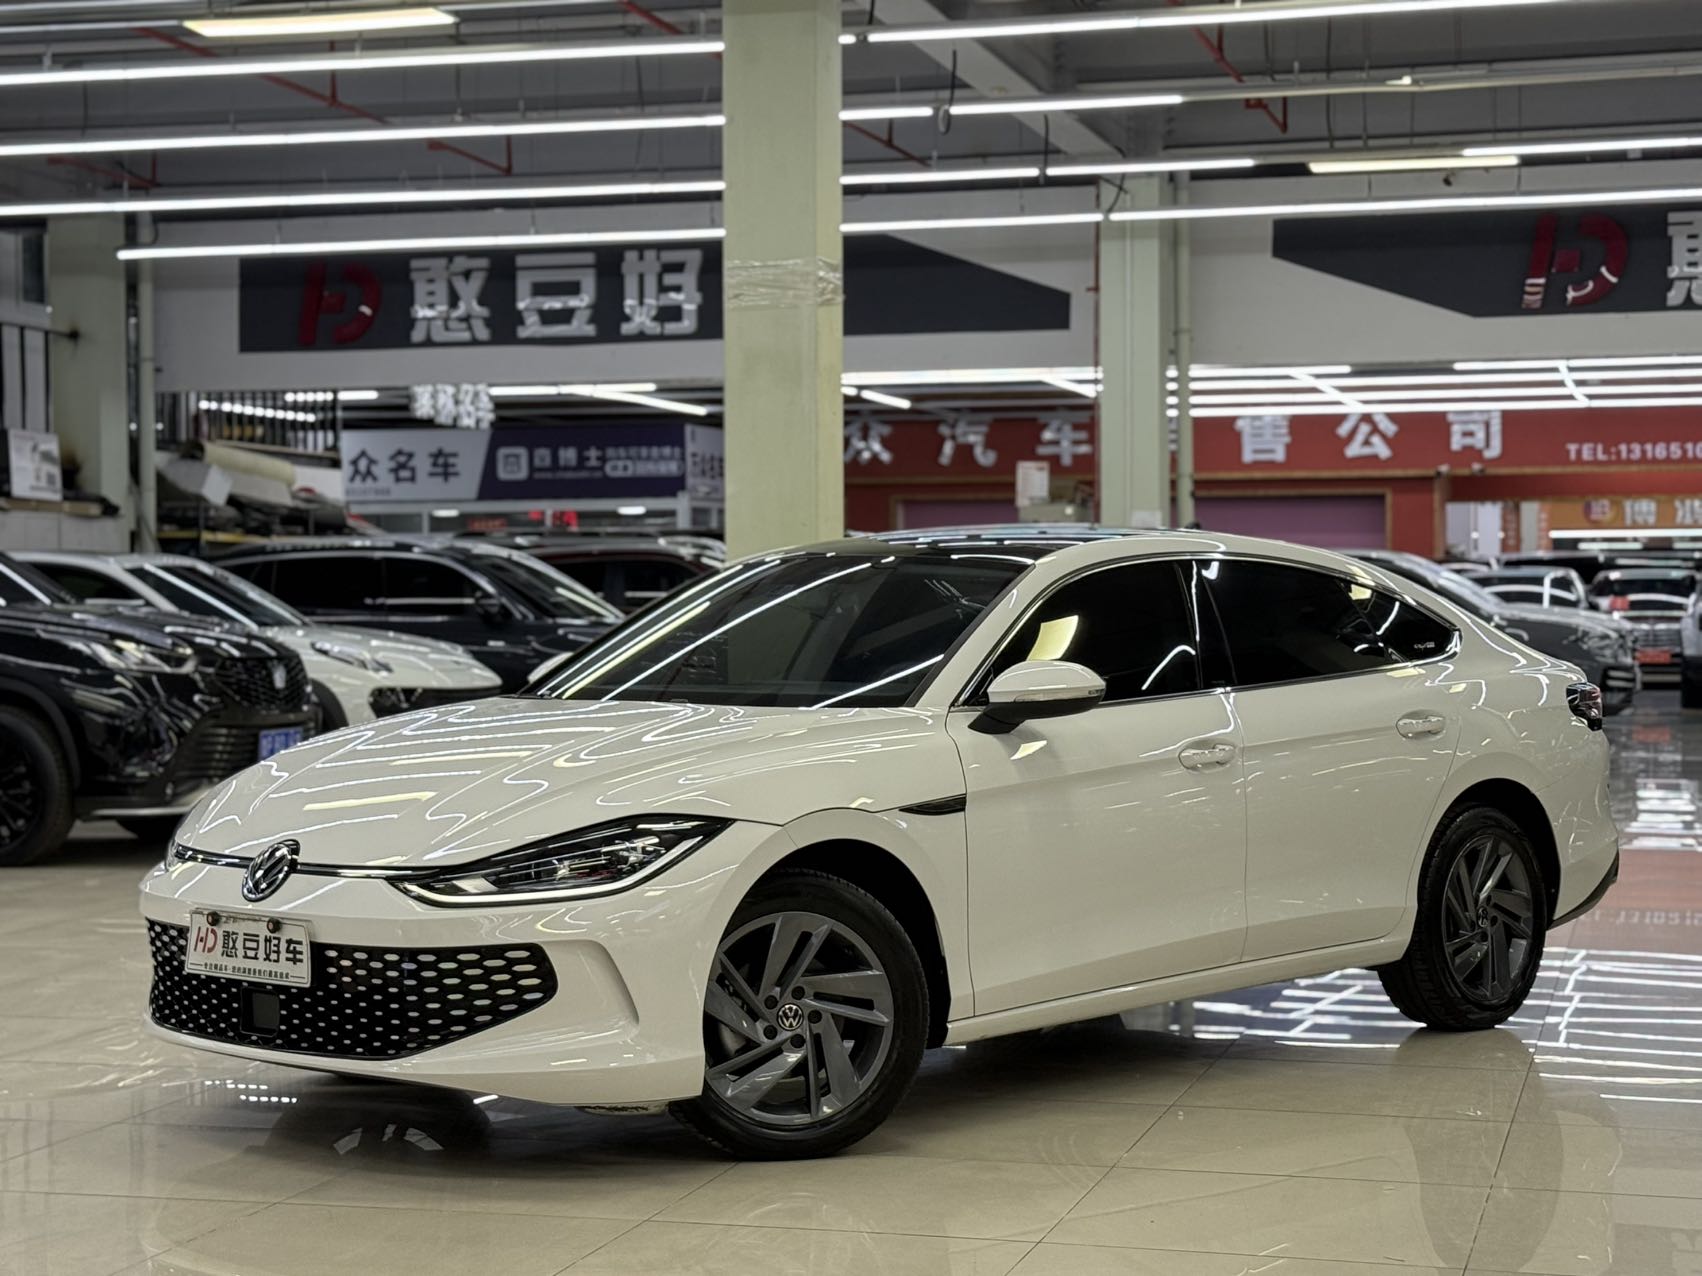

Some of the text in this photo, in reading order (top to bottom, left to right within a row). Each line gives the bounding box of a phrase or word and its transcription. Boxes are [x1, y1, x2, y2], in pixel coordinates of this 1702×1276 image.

[409, 249, 702, 343] 憨豆好
[349, 448, 460, 484] 众名车
[221, 930, 304, 966] 憨豆好车
